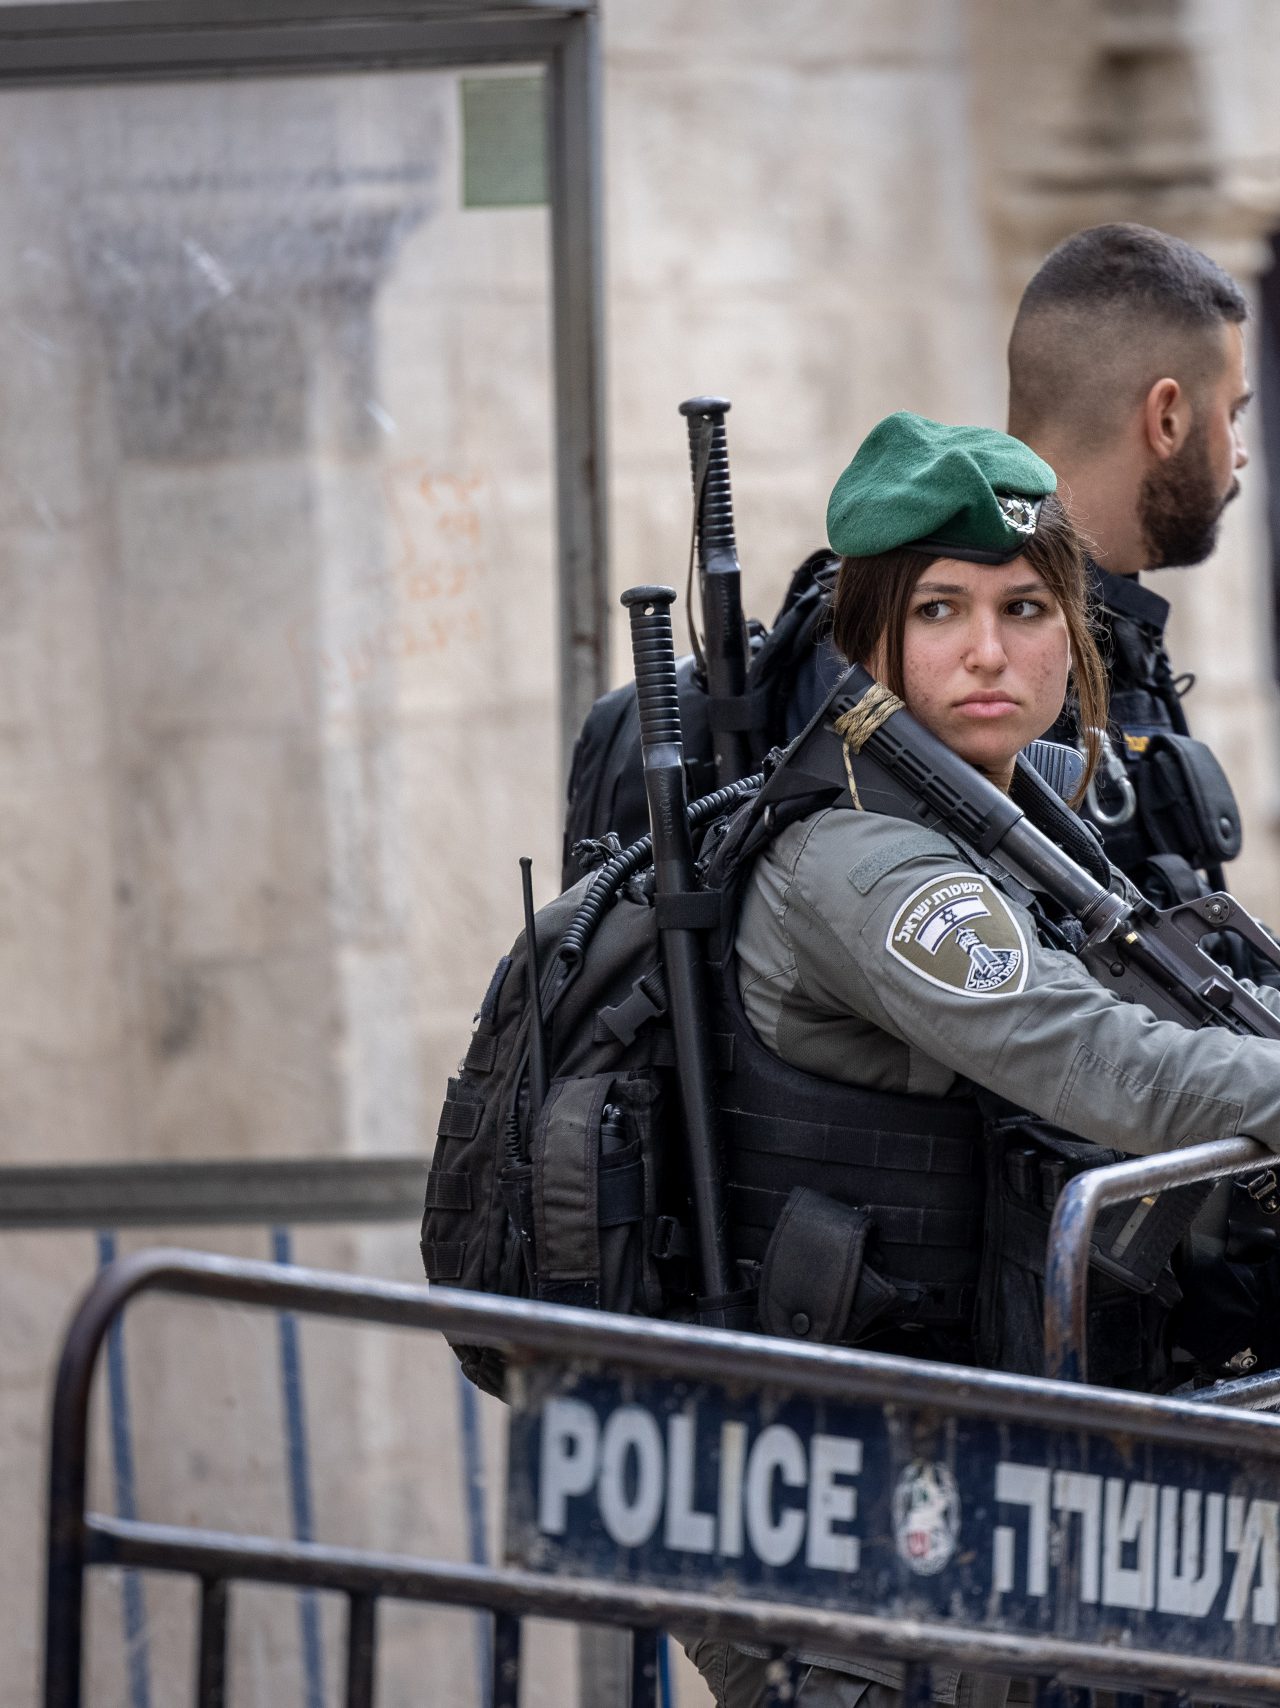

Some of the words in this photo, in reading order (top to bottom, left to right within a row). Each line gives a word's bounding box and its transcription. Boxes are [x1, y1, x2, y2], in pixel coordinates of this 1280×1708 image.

[932, 883, 983, 906] משטרת
[895, 898, 933, 943] ישראל
[539, 1399, 864, 1574] POLICE
